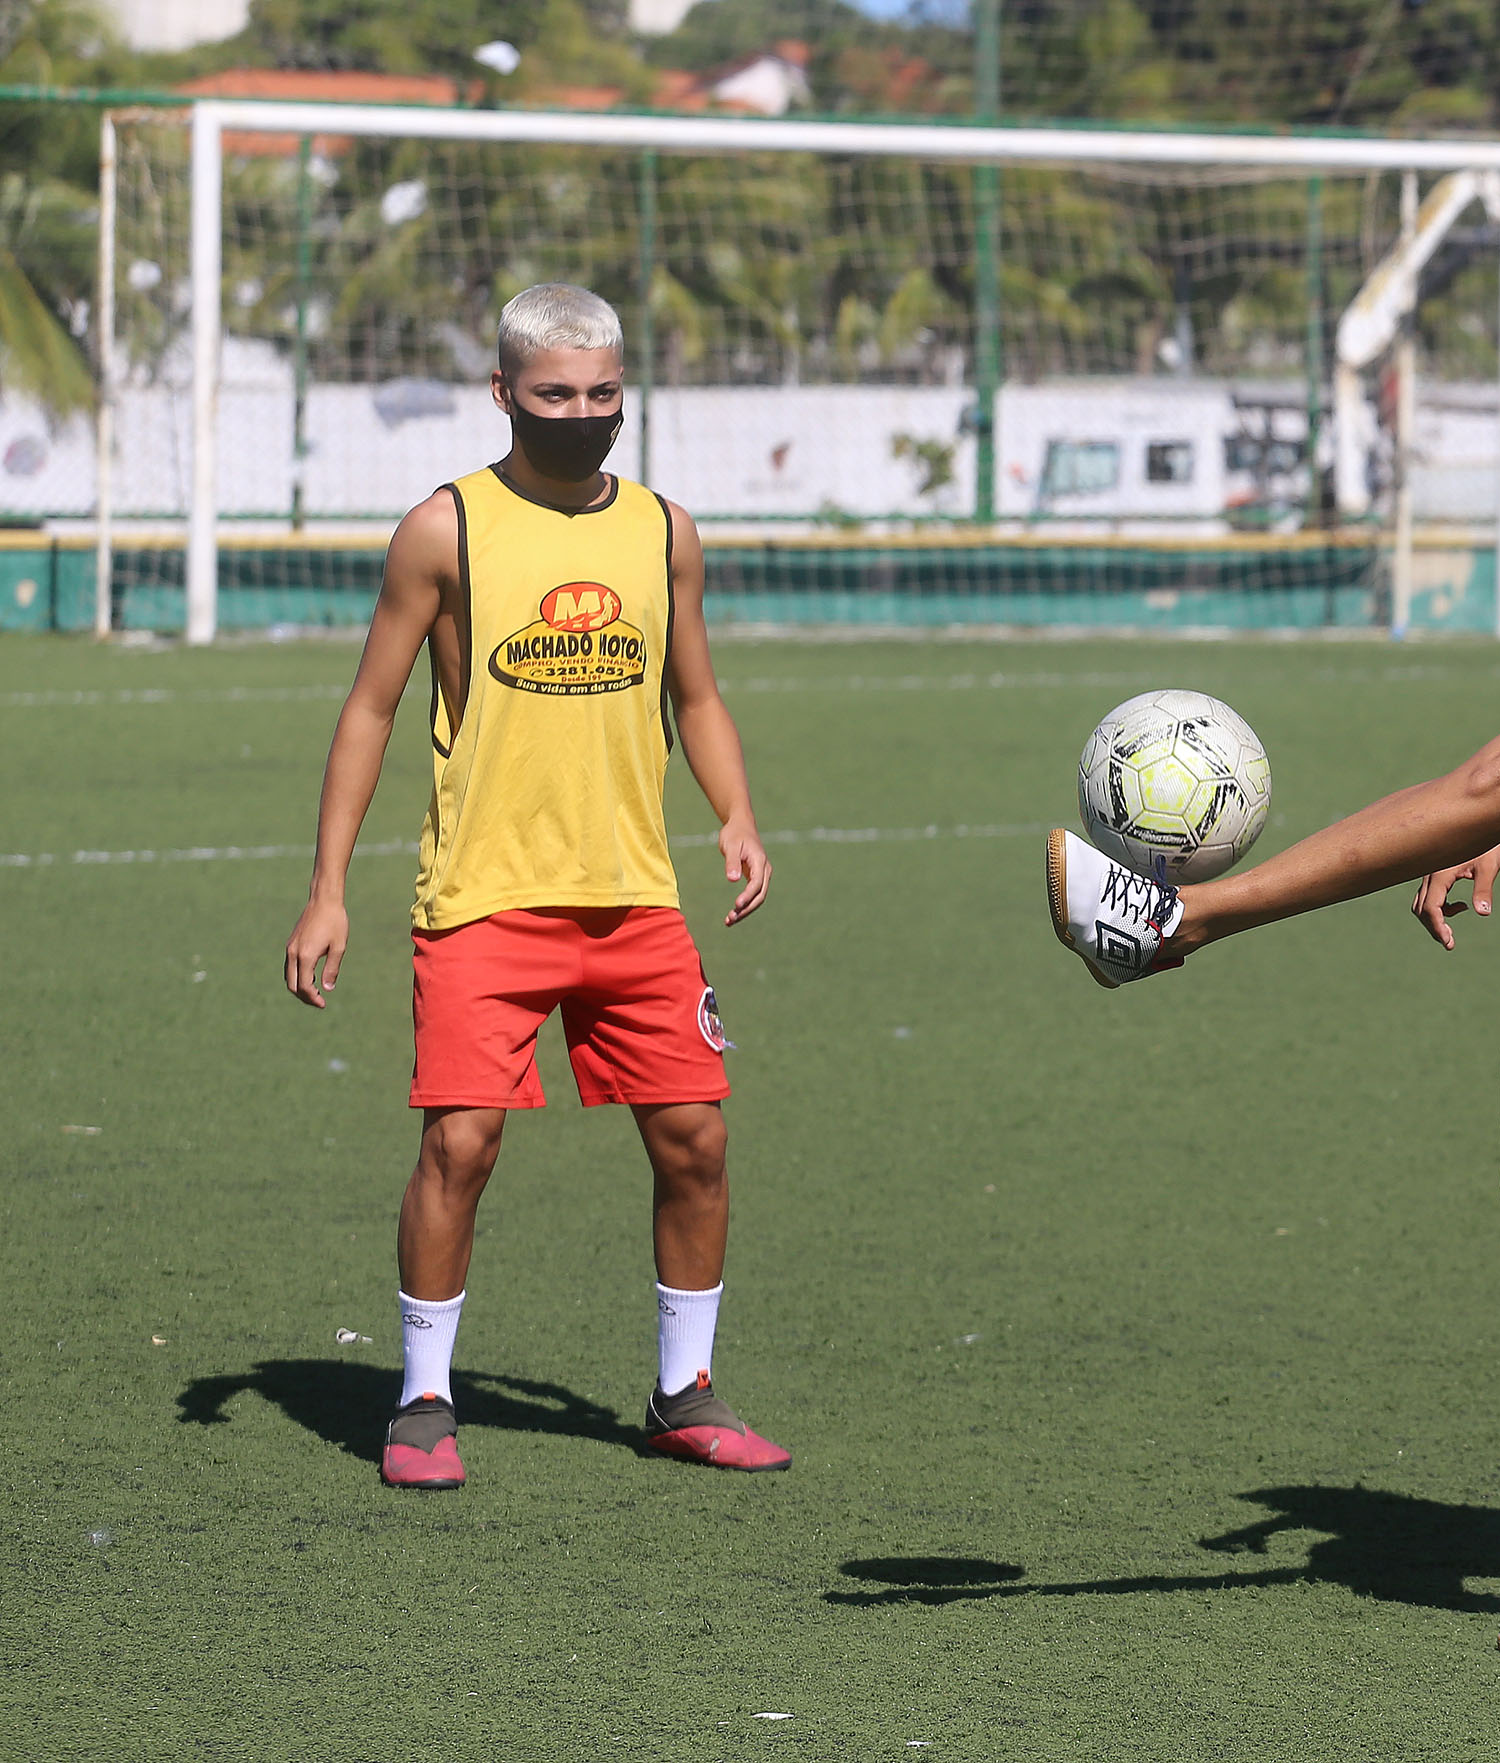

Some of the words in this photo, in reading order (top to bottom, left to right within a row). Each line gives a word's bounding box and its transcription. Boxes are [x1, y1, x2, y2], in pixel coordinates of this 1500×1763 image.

[507, 632, 593, 665] MACHADO
[559, 657, 594, 665] VENDO
[515, 678, 538, 692] Sua
[540, 683, 567, 694] vida
[569, 685, 588, 694] em
